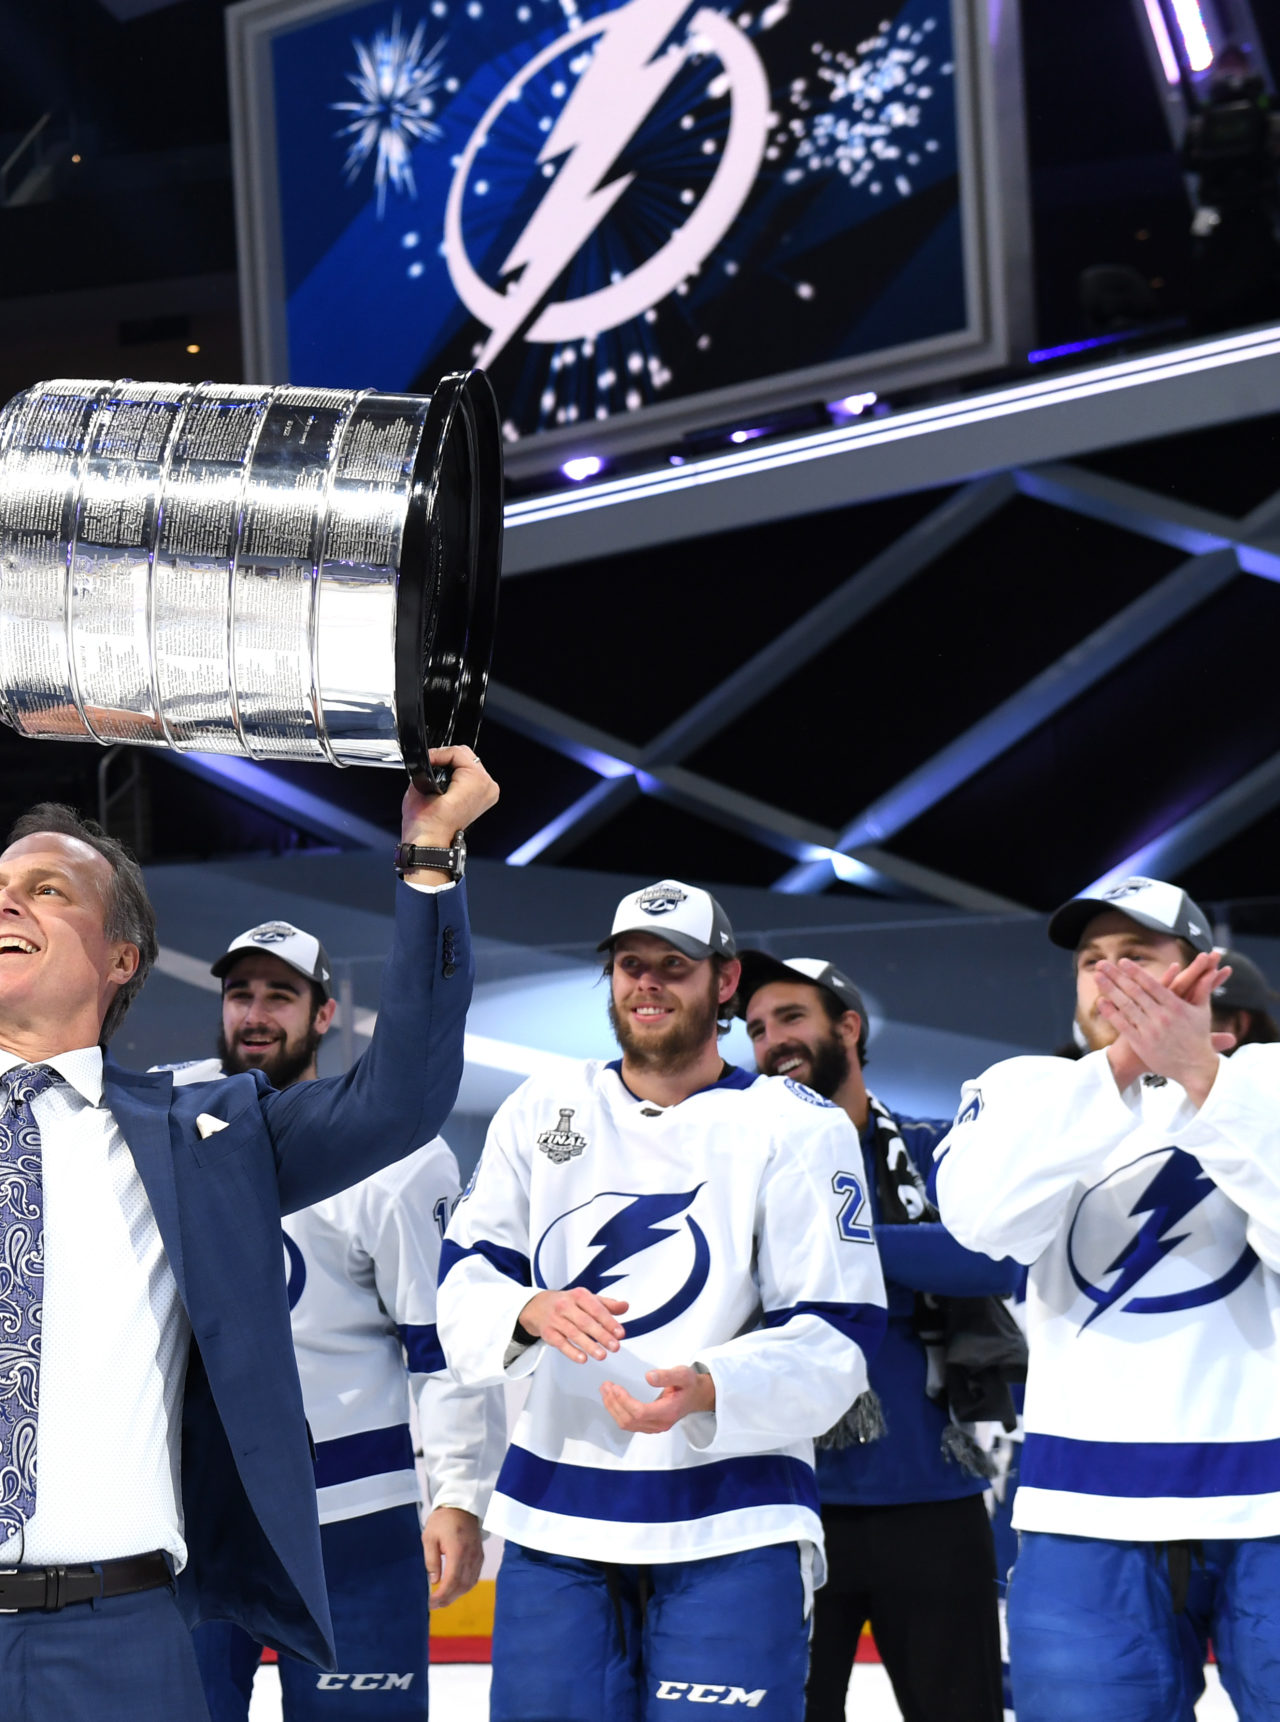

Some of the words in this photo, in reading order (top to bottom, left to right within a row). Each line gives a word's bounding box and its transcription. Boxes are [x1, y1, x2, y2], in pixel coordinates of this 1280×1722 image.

[537, 1132, 588, 1149] FINAL
[315, 1672, 415, 1691] CCM
[655, 1680, 768, 1708] CCM
